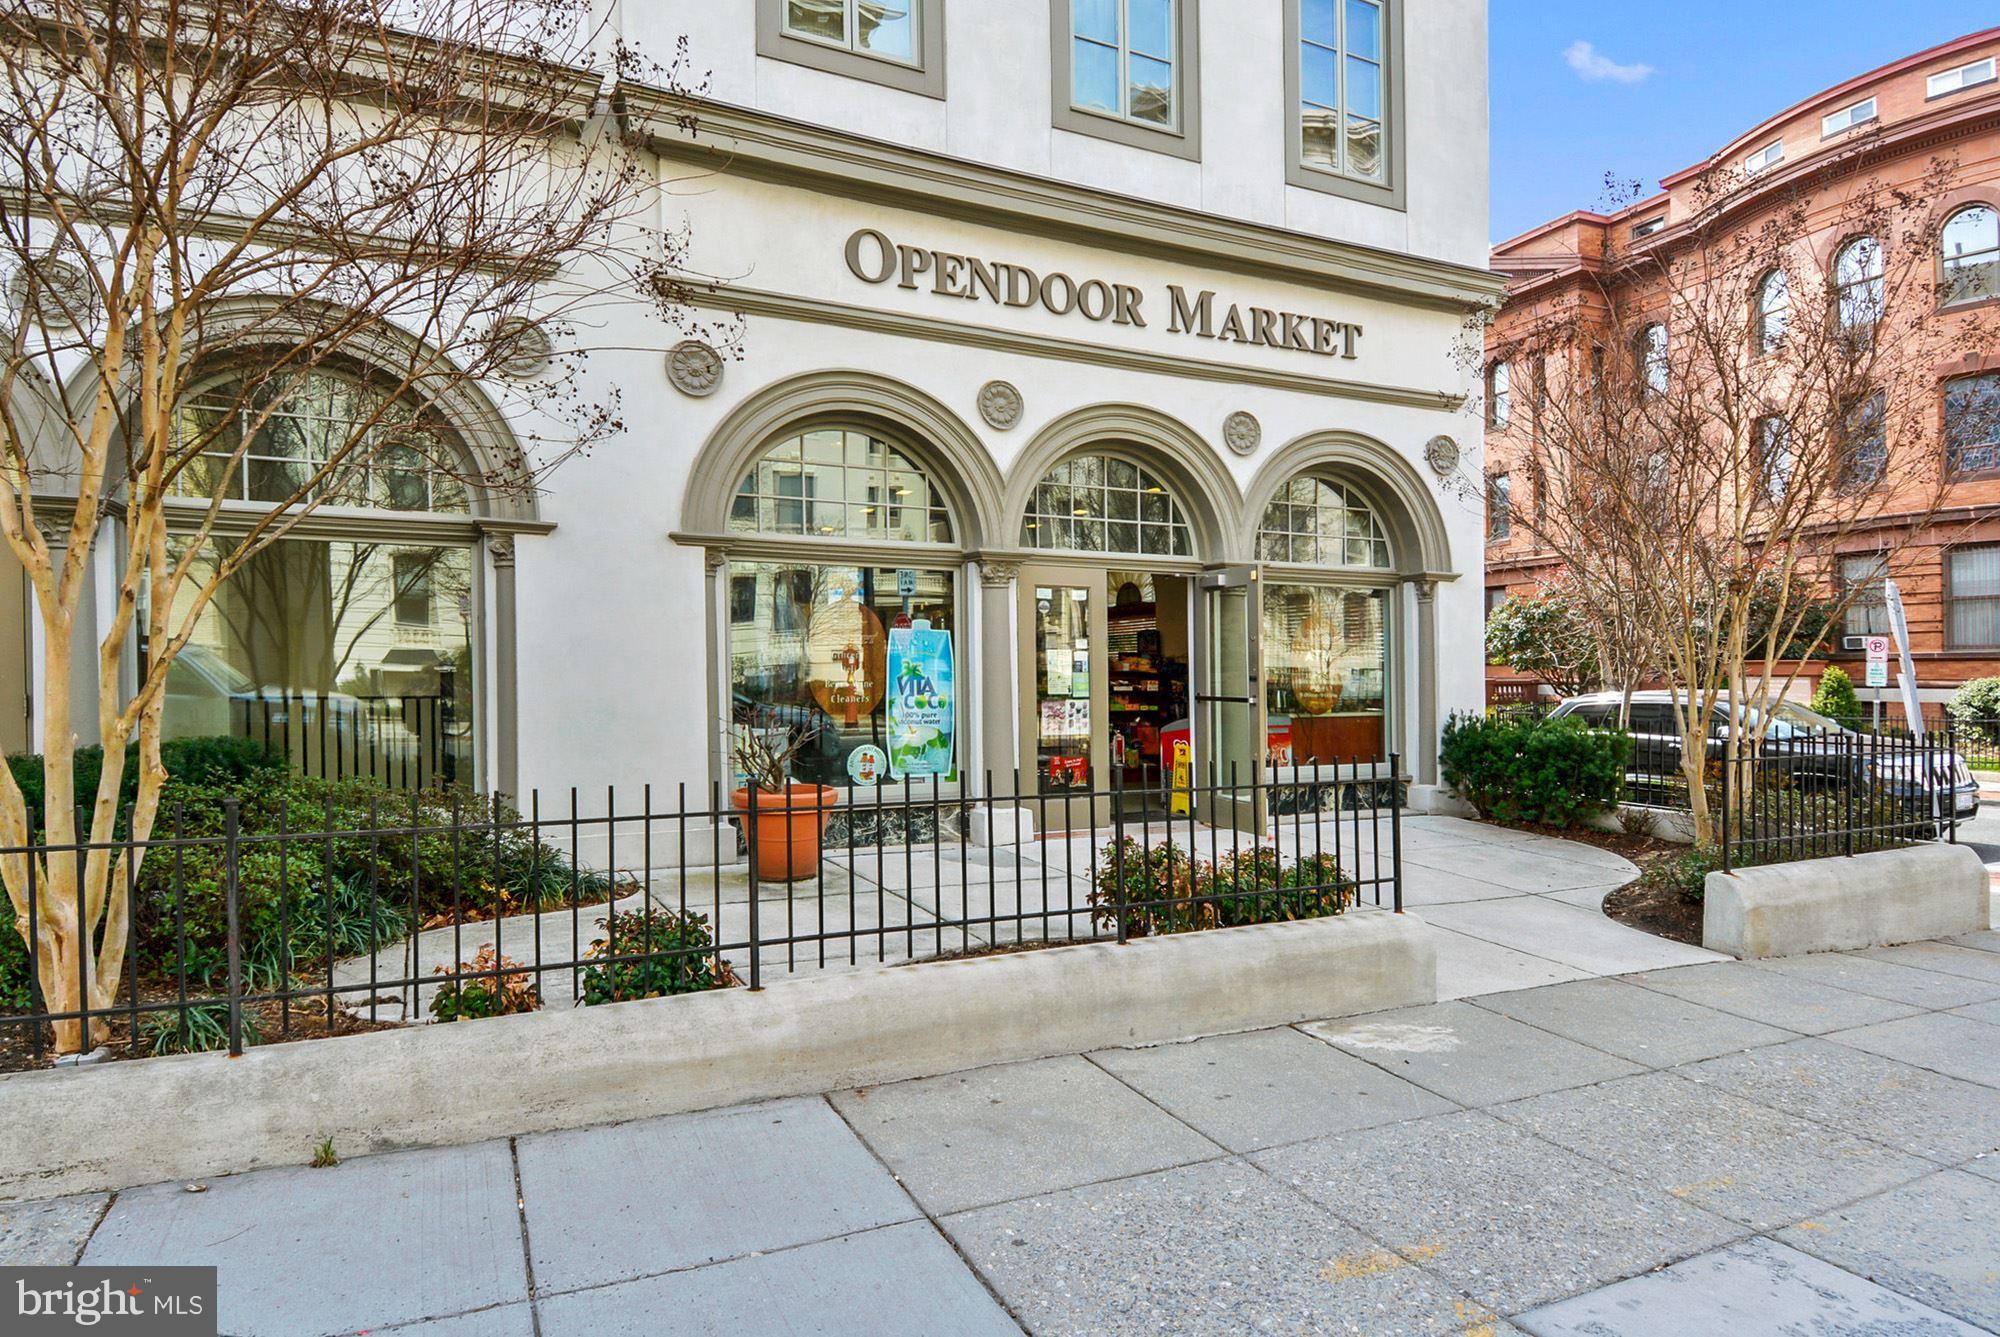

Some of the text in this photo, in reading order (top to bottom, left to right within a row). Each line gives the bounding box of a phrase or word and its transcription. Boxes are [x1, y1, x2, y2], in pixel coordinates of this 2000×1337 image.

[1166, 284, 1363, 360] MARKET
[896, 673, 938, 697] VITA
[830, 694, 870, 703] Cleaners
[904, 694, 948, 710] COCO
